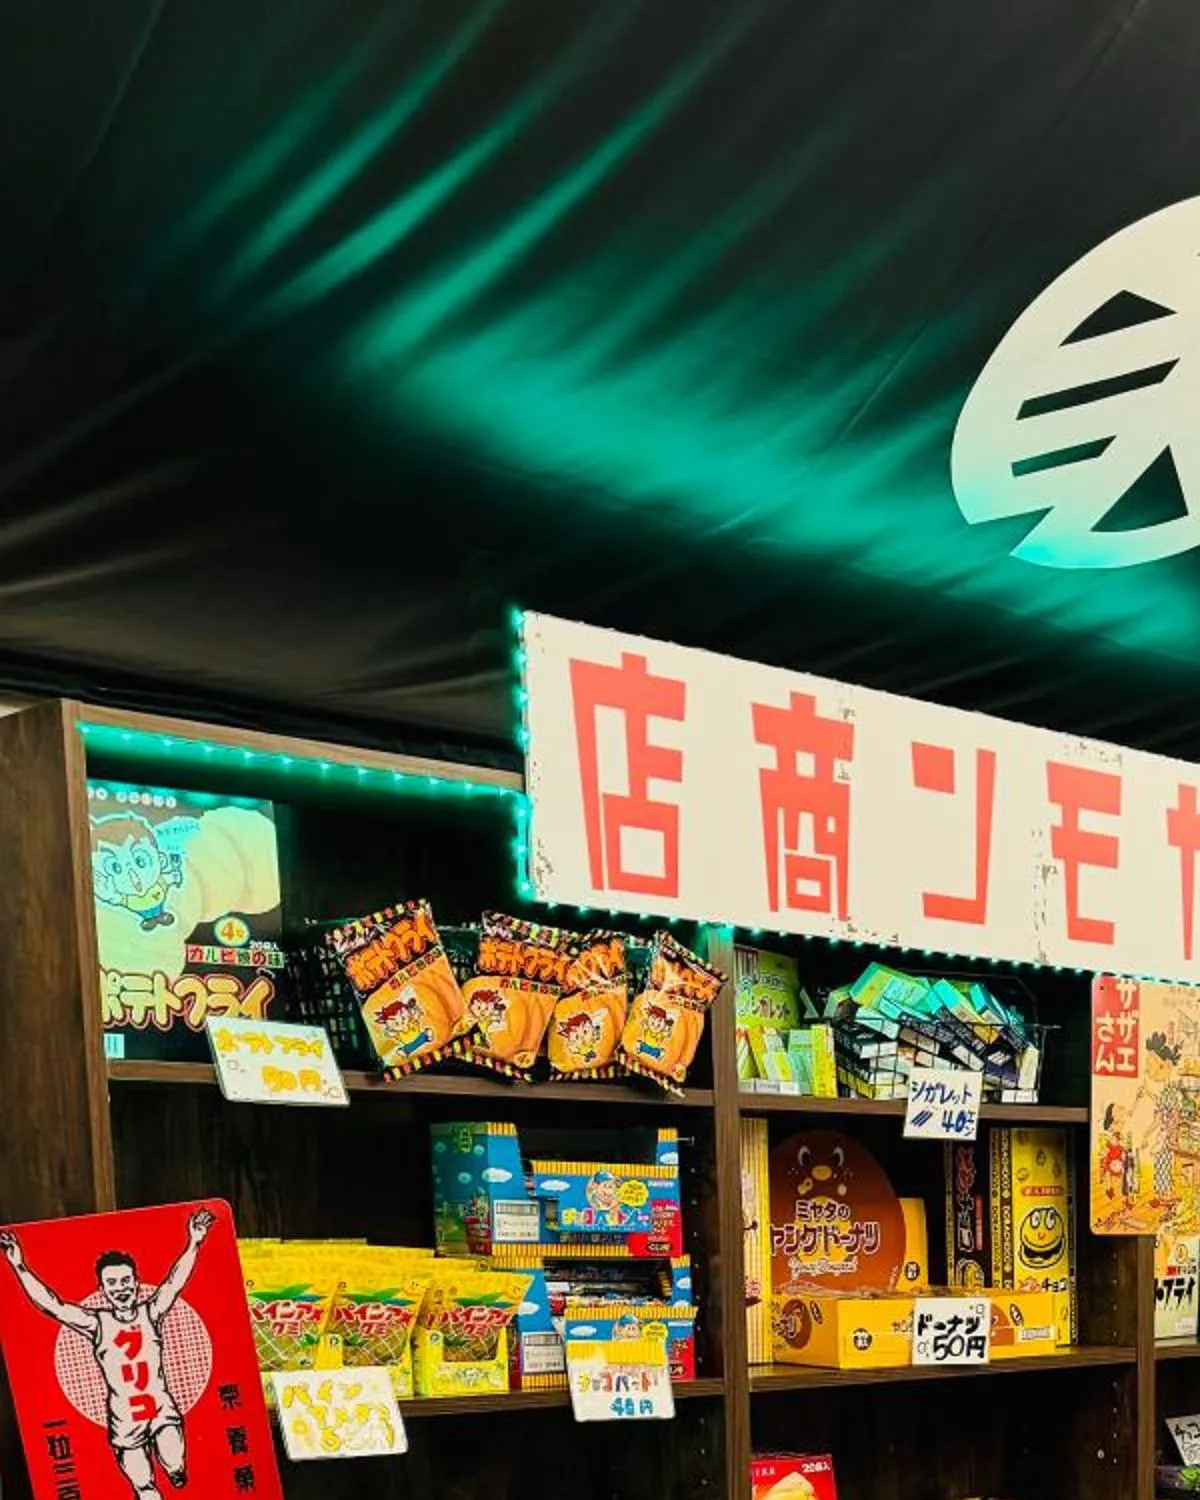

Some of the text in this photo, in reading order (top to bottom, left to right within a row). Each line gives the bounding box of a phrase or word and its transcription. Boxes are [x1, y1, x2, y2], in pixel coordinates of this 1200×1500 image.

[1095, 1012, 1116, 1072] さん
[1115, 979, 1139, 1072] サザエ
[911, 1081, 972, 1103] シガレット
[917, 1314, 982, 1336] ドーナツ
[934, 1335, 987, 1359] 50円
[113, 1323, 159, 1424] グリコ
